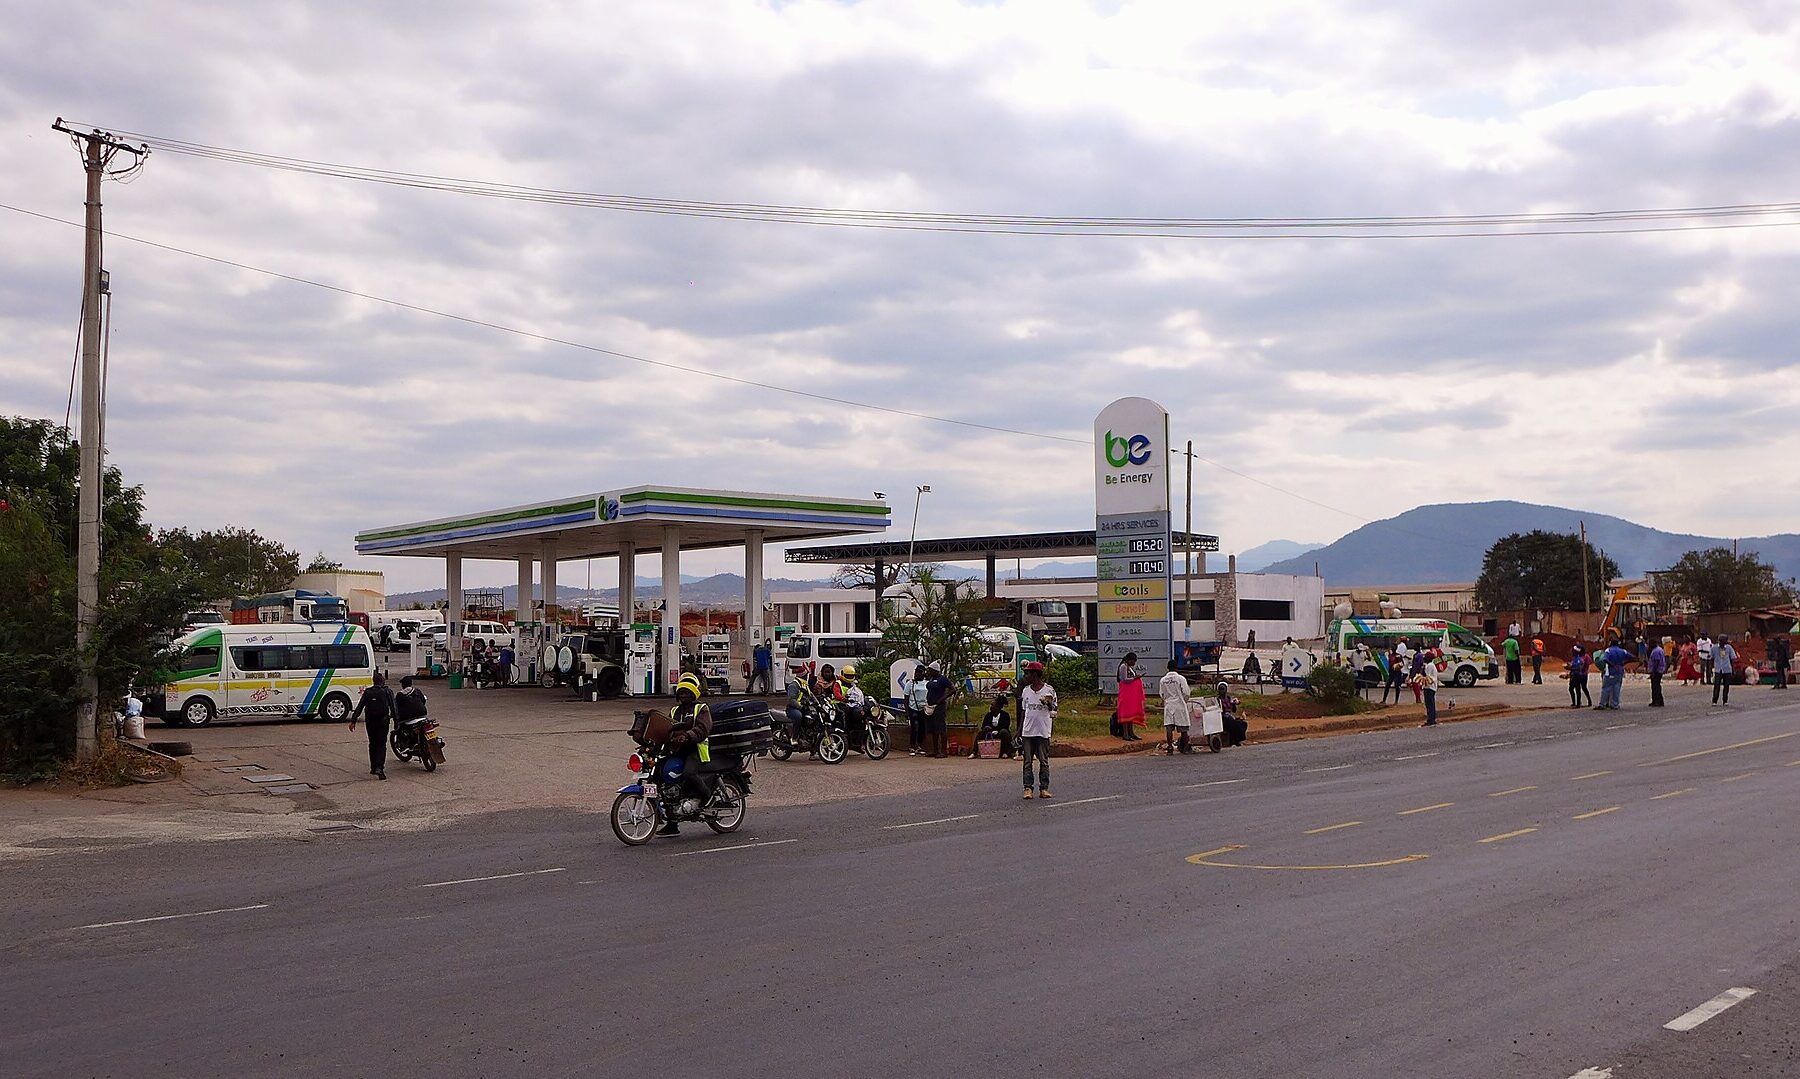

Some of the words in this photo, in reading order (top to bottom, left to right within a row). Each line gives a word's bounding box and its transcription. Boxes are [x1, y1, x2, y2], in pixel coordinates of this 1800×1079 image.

[1105, 430, 1152, 467] be
[1105, 475, 1118, 485] Be
[1120, 473, 1153, 484] Energy
[599, 495, 619, 521] be
[1101, 522, 1110, 531] 24
[1111, 522, 1126, 530] HRS
[1126, 519, 1160, 529] SERVICES
[768, 602, 773, 610] 2
[1115, 602, 1149, 614] Benefit
